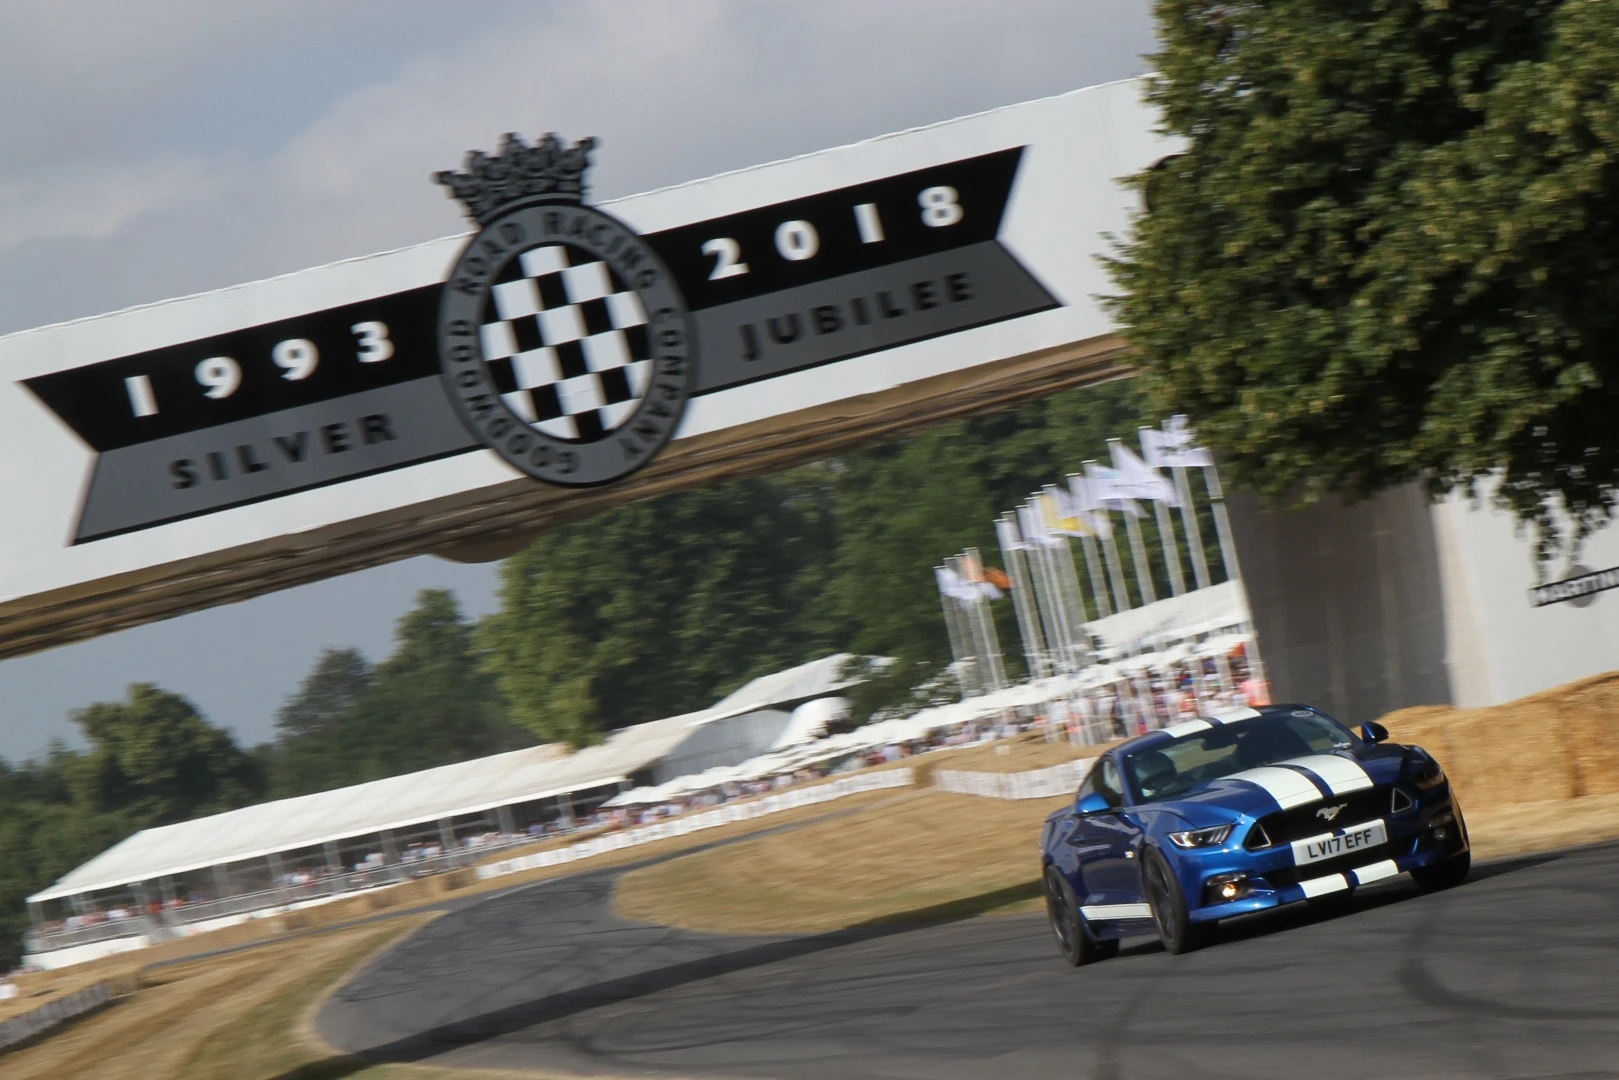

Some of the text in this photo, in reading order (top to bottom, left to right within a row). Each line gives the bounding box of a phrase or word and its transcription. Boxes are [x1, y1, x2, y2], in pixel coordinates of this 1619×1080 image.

[701, 186, 964, 281] 2018
[739, 272, 976, 361] JUBILEE
[124, 321, 395, 418] 1993
[169, 414, 397, 489] SILVER
[1345, 829, 1372, 849] EFF
